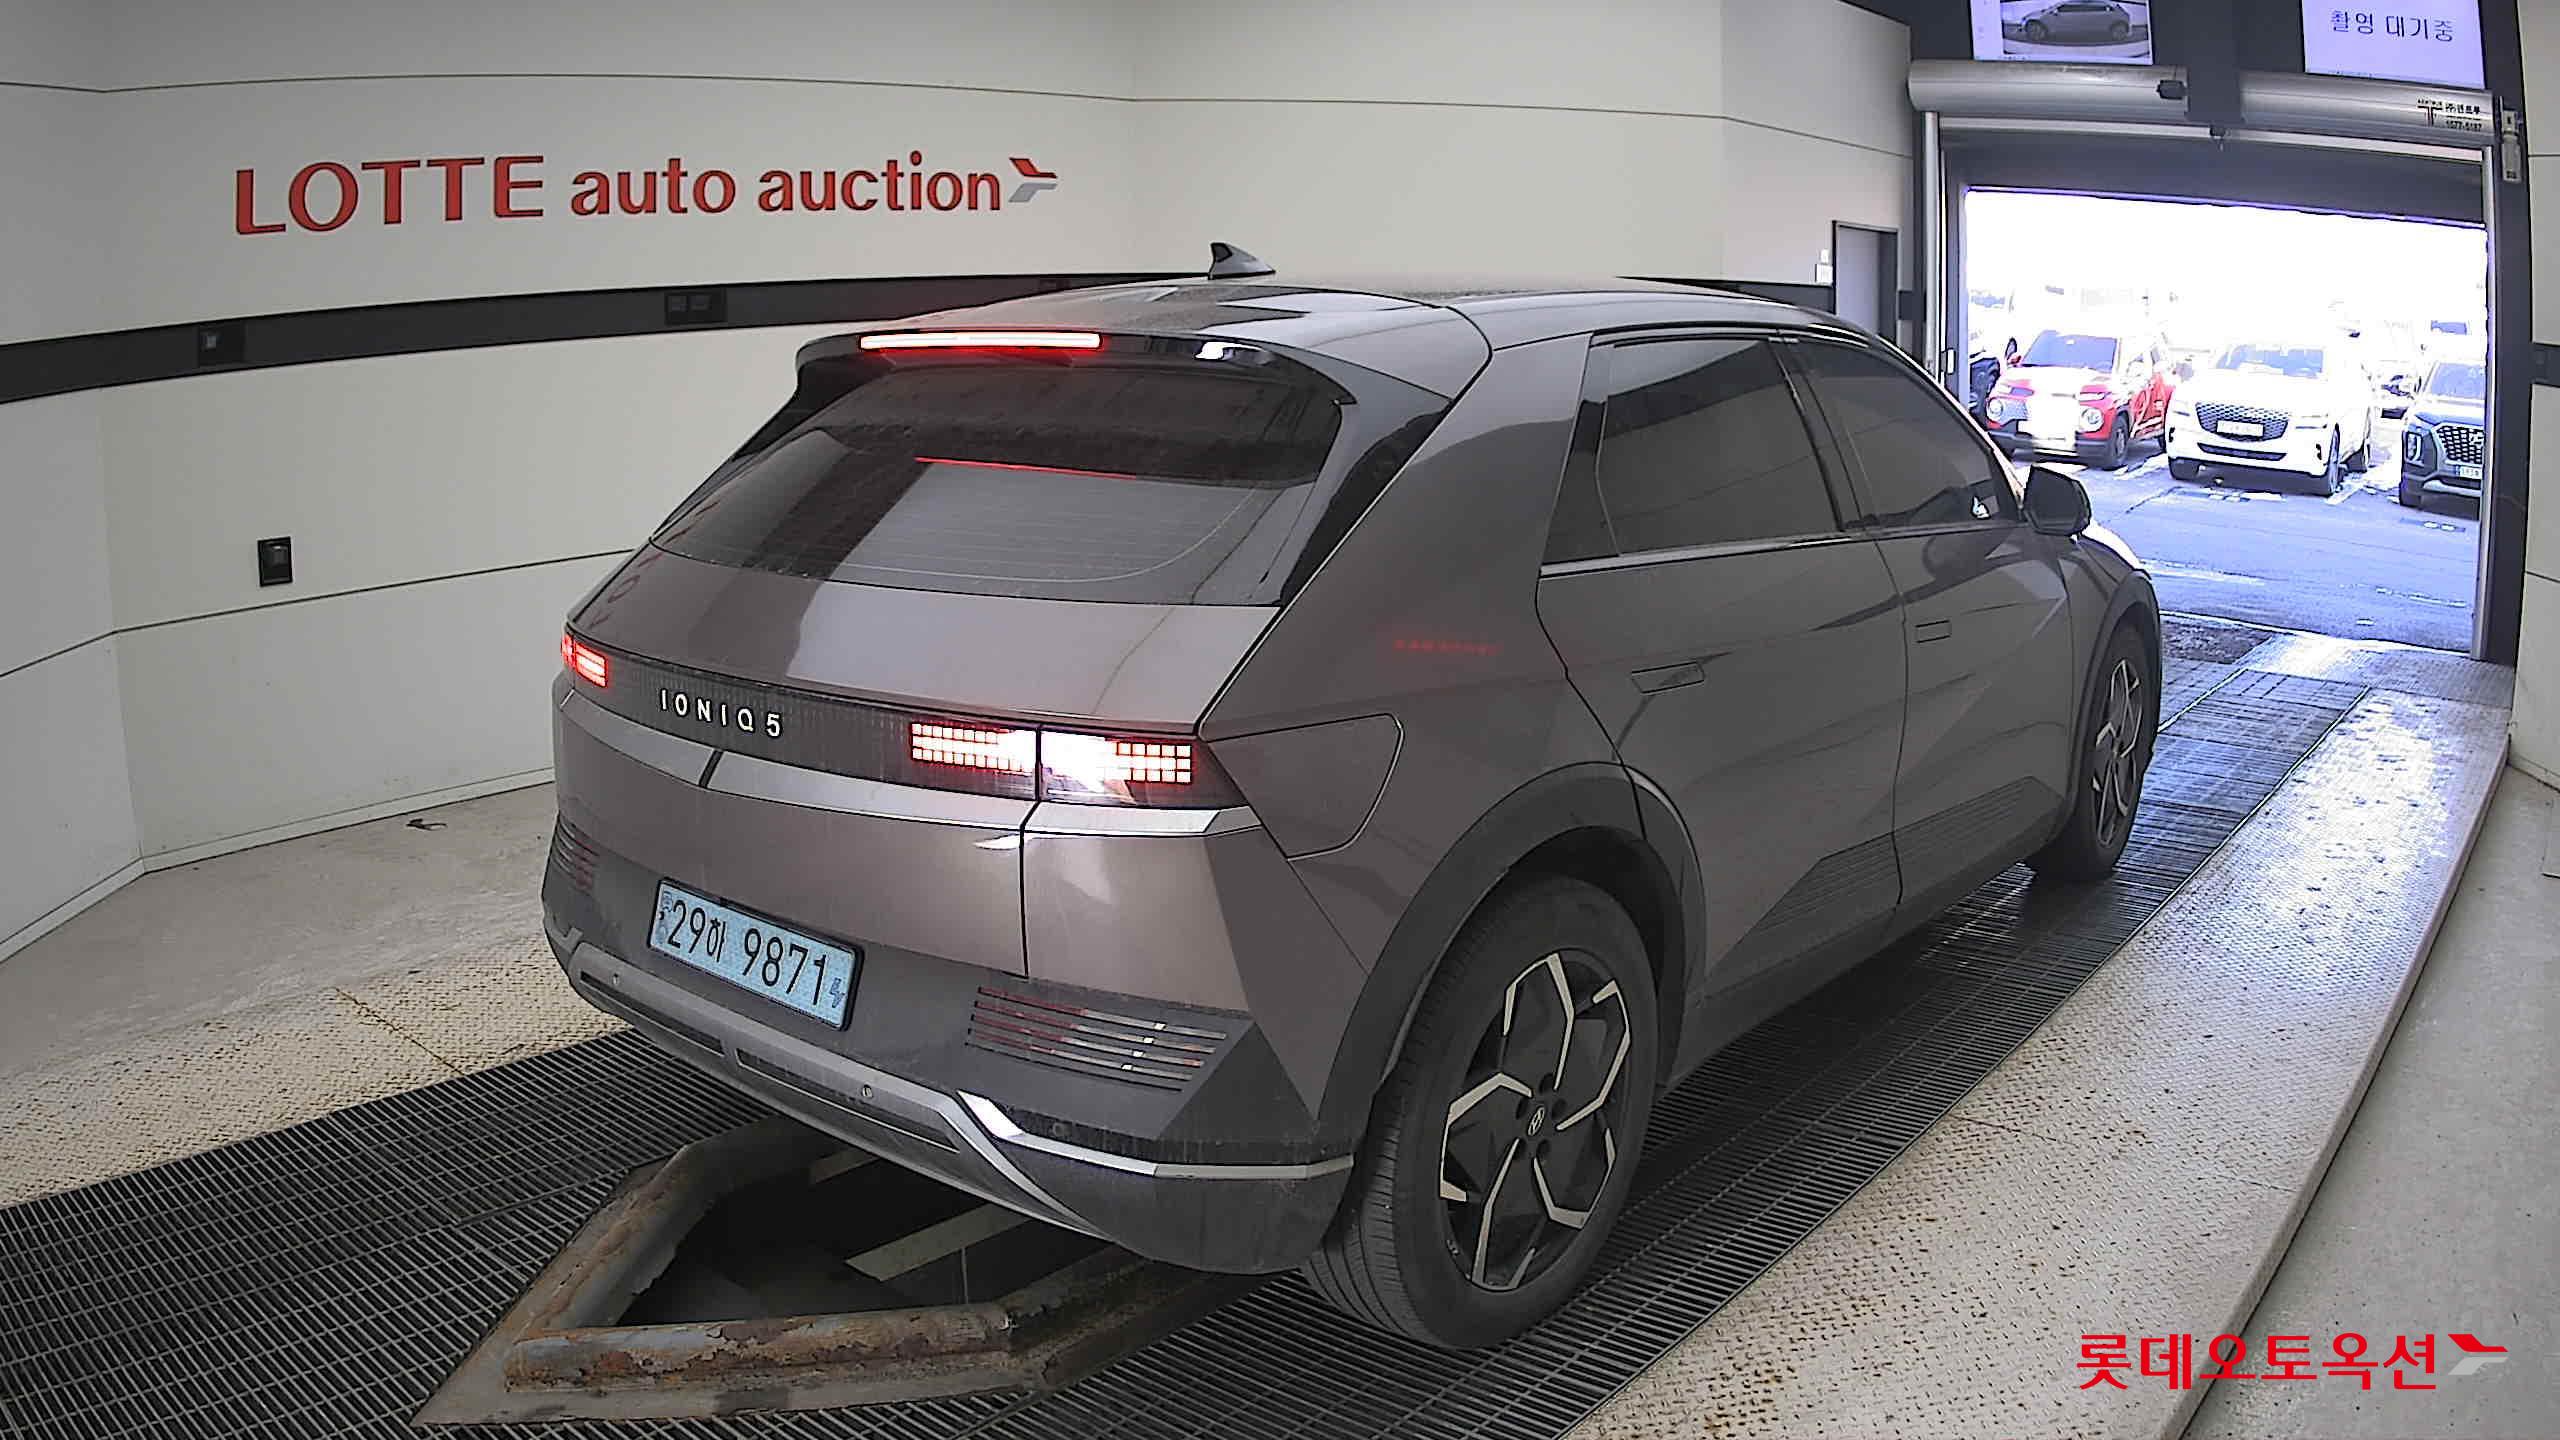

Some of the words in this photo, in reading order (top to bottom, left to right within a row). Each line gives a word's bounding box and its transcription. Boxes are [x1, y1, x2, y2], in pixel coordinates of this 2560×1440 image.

[2331, 10, 2374, 34] 촬영
[2386, 15, 2453, 42] 대기중
[236, 156, 544, 234] LOTTE
[571, 158, 736, 215] auto
[758, 151, 1003, 212] auction
[660, 688, 754, 732] IONIQ
[766, 712, 781, 738] 5
[667, 900, 726, 963] 29하
[742, 928, 827, 1006] 9871
